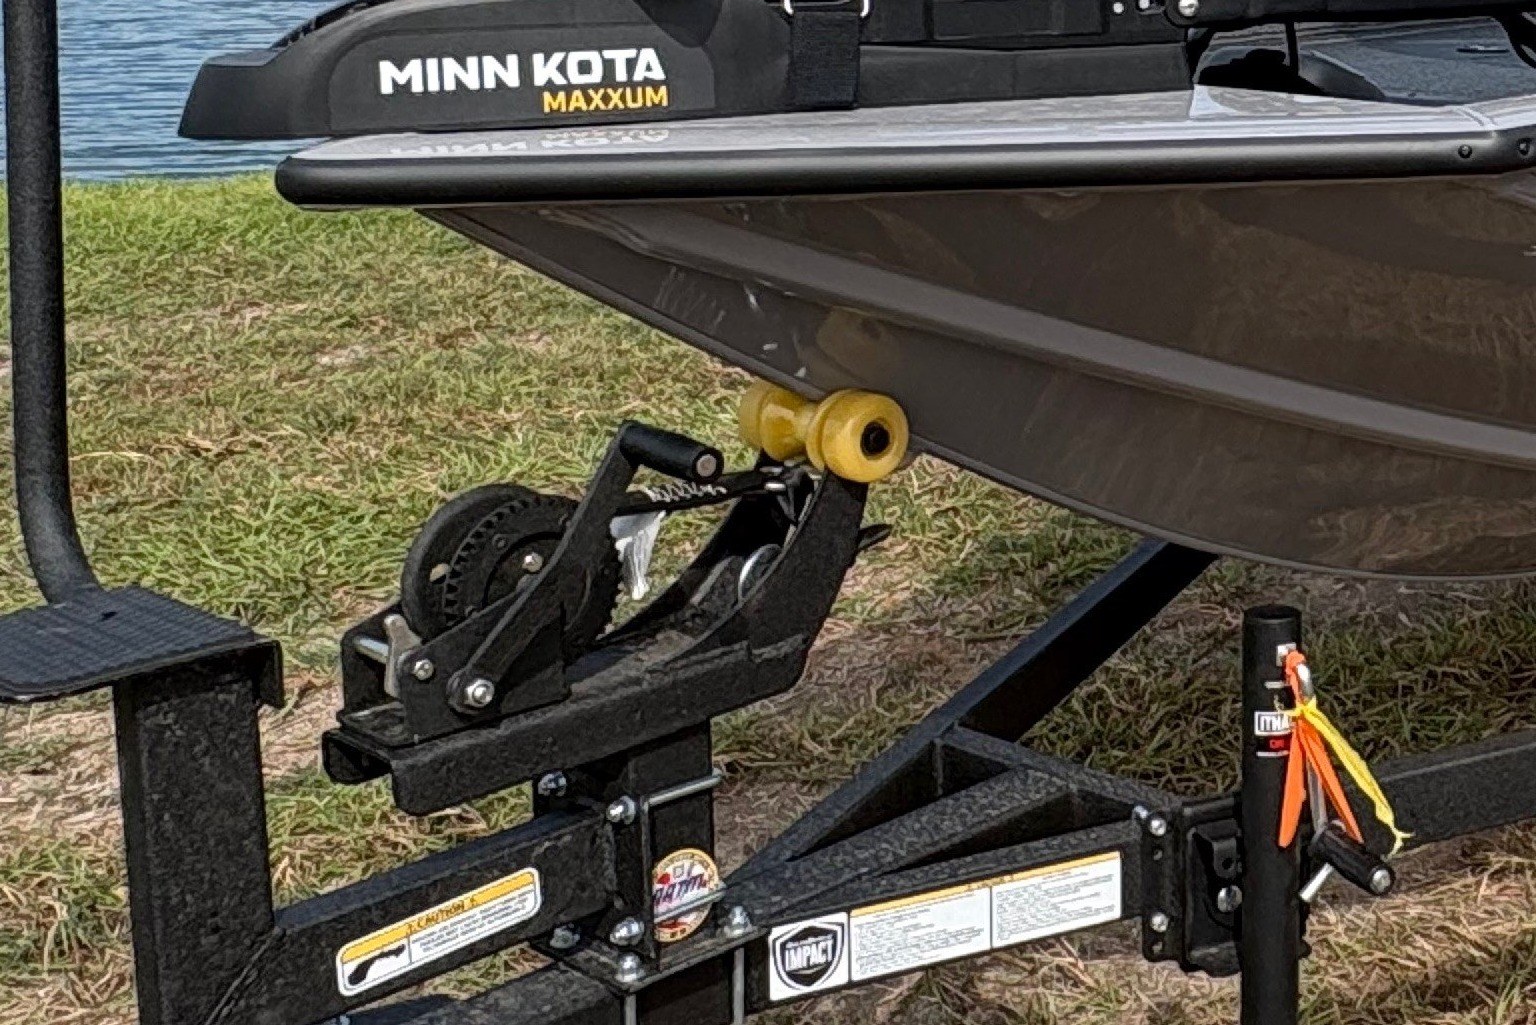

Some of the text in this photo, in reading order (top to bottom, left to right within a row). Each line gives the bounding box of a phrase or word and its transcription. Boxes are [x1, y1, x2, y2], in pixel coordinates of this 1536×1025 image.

[379, 47, 667, 95] MINN KOTA
[543, 85, 669, 114] MAXXUM
[784, 938, 834, 972] IMPACT
